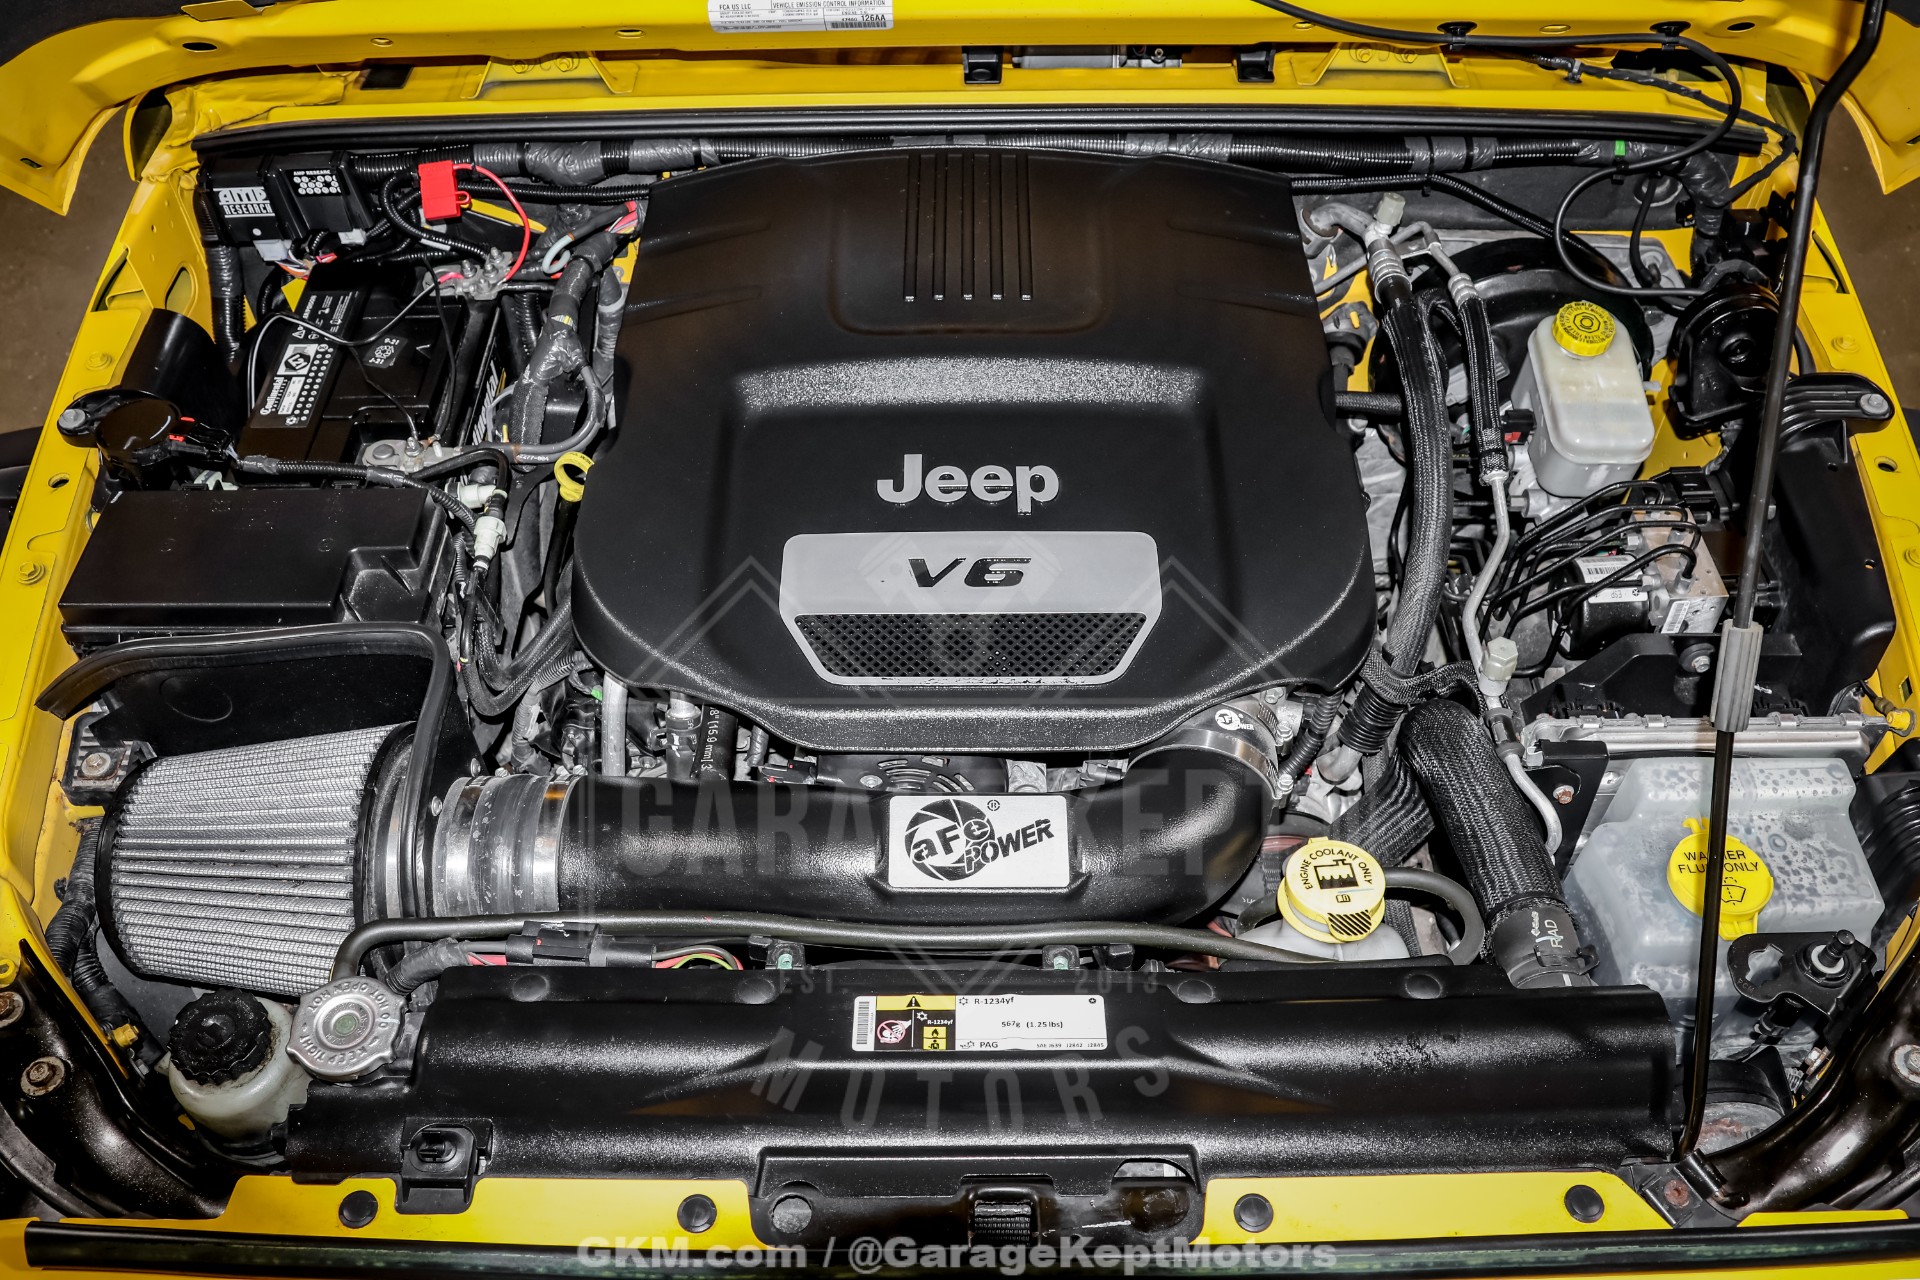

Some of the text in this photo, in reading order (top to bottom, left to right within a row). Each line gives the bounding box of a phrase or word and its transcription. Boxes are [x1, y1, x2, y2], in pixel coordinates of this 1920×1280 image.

[860, 14, 887, 22] 126AA
[218, 188, 267, 203] AMP
[222, 203, 274, 215] RESEARCH
[260, 376, 285, 415] Continental
[876, 453, 1060, 516] Jeep
[908, 557, 1032, 588] V6
[912, 818, 991, 864] aFe
[964, 817, 1055, 874] POWER
[1684, 849, 1747, 861] WAER
[1299, 848, 1374, 890] ENGINE COOLANT ONLY
[1723, 861, 1759, 873] ONLY
[1543, 919, 1564, 949] RAD
[333, 982, 369, 995] OPEN
[308, 989, 331, 1013] HOT
[369, 989, 389, 1011] NOT
[974, 996, 1015, 1005] R-1234yf
[1001, 1020, 1021, 1029] 567g
[299, 1034, 368, 1066] KEEP TIGHT
[979, 1041, 999, 1049] PAG
